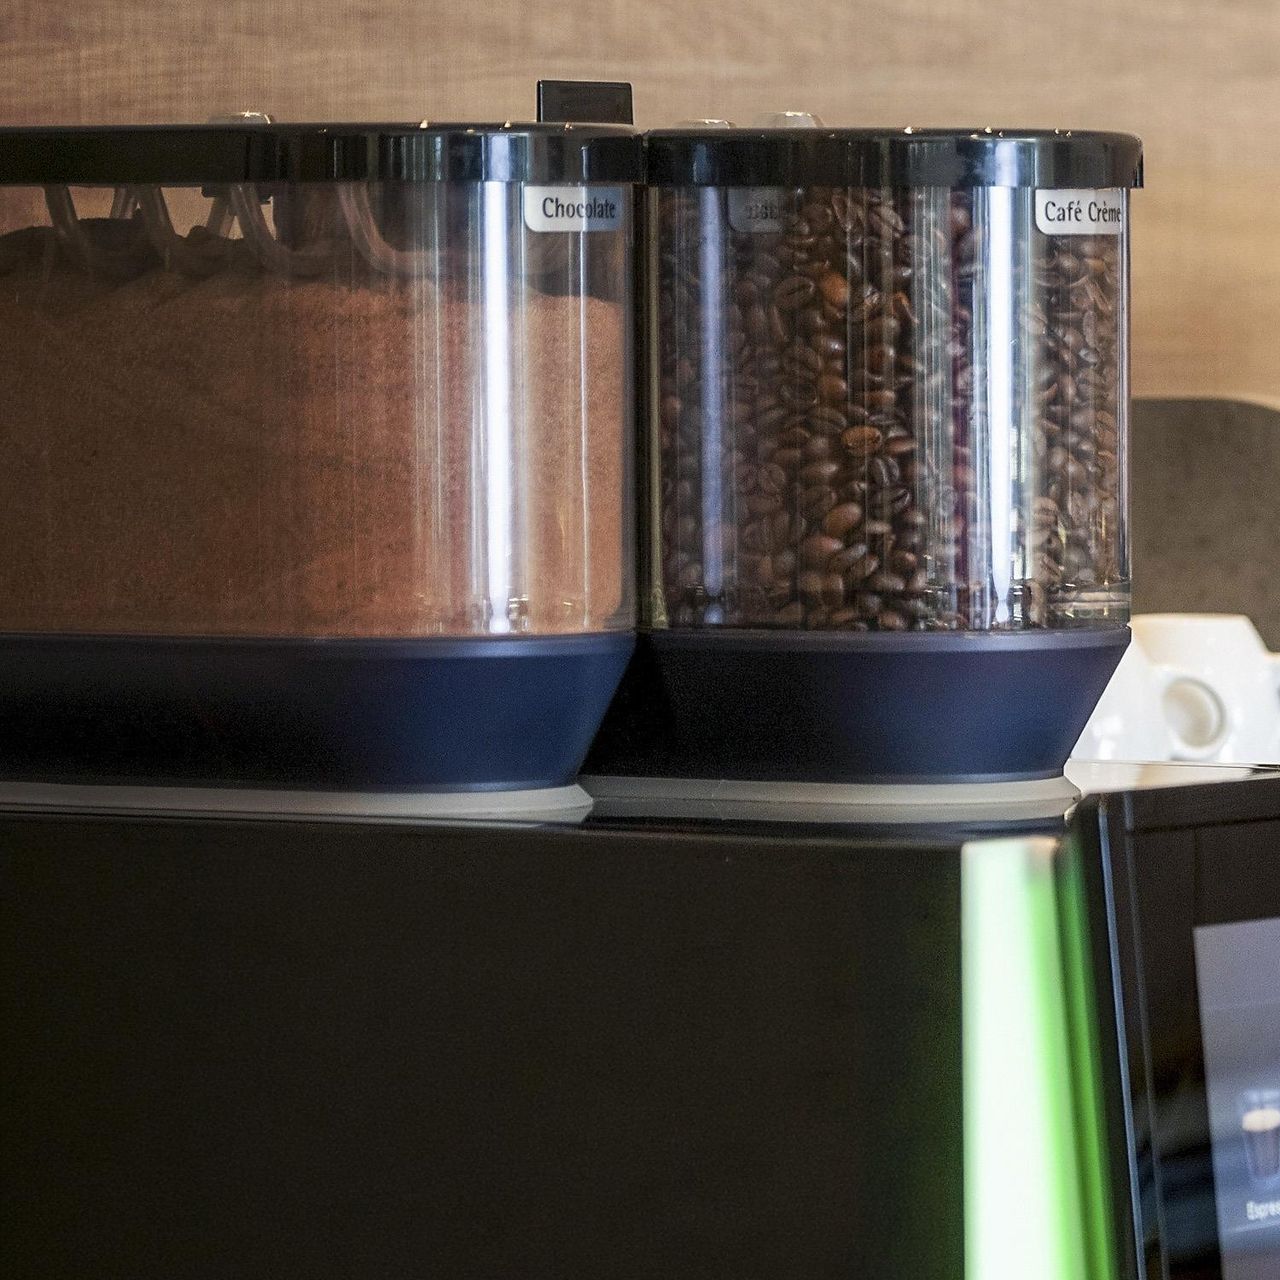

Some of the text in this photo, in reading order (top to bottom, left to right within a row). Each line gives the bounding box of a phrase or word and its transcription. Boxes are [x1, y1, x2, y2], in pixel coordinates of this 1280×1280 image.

[542, 196, 615, 219] Chocolate
[1045, 200, 1121, 223] Café Crème
